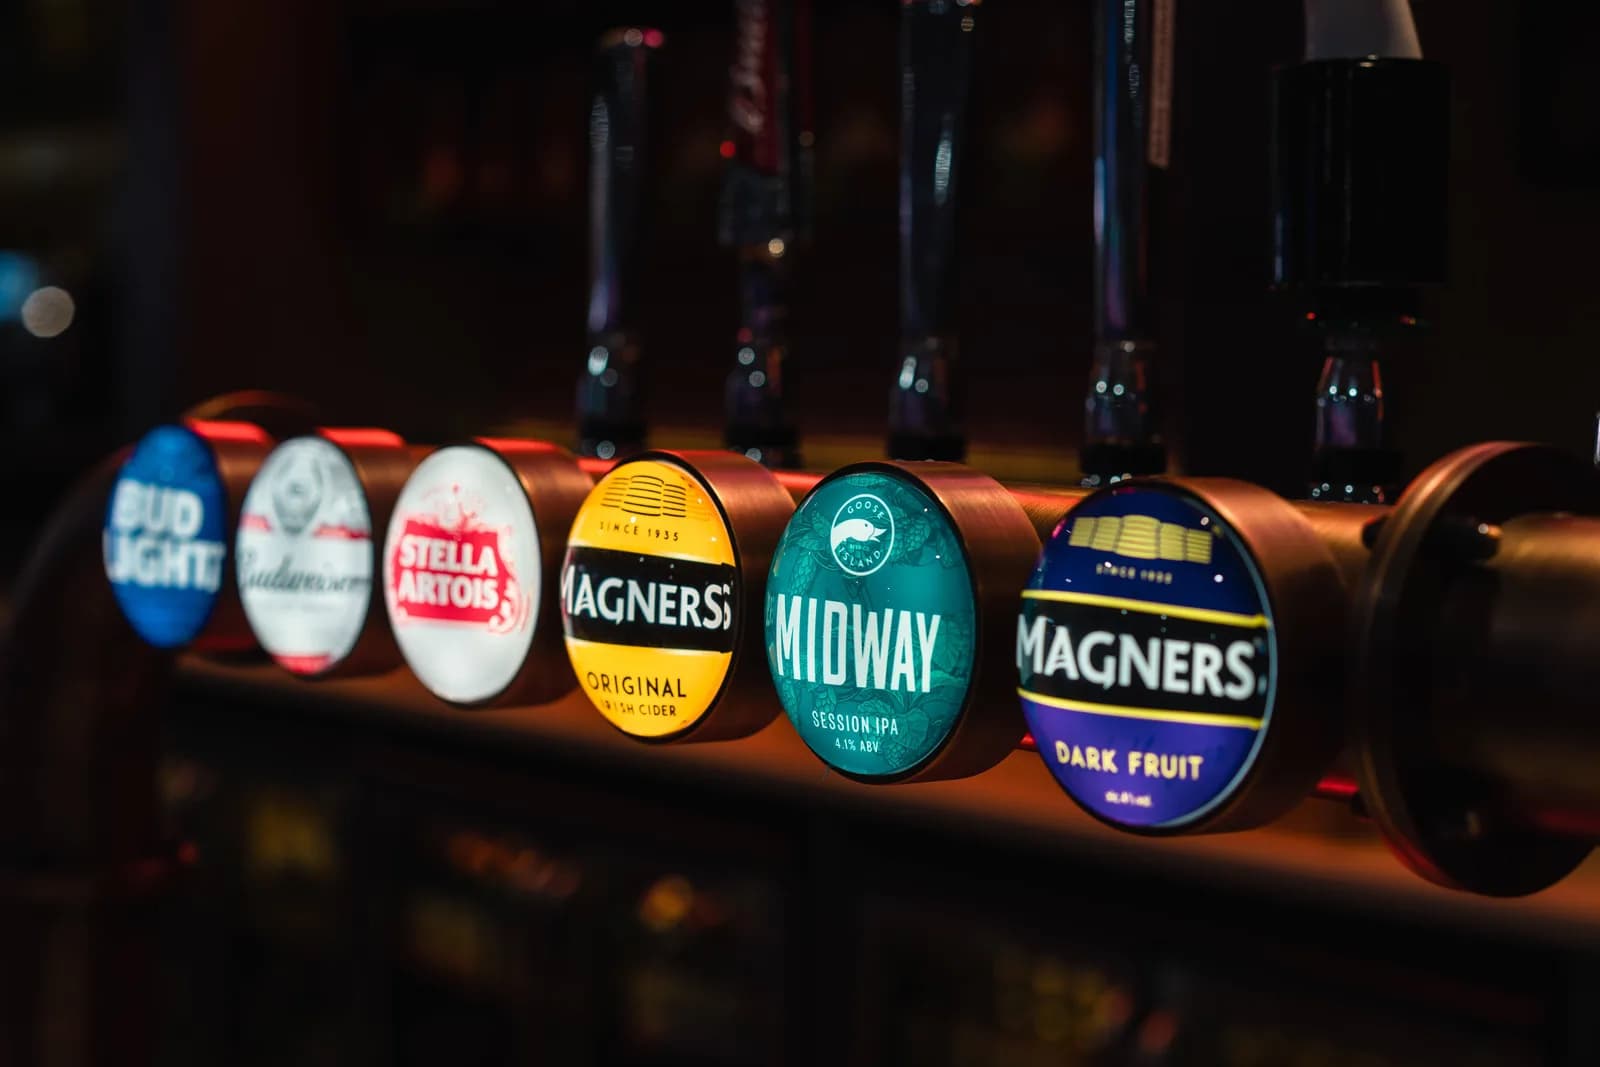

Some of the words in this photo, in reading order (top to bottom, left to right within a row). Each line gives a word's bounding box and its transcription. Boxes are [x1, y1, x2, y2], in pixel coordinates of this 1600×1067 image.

[112, 478, 202, 538] BUD
[847, 501, 885, 519] GOOSE
[600, 521, 638, 536] SINCE
[648, 527, 679, 542] 1935
[401, 535, 498, 577] STELLA
[839, 546, 881, 568] ISLAND
[399, 569, 499, 610] ARTOIS
[775, 593, 941, 693] MIDWAY
[1016, 613, 1256, 701] MAGNERS
[587, 672, 687, 698] ORIGINAL
[639, 704, 676, 717] CIDER
[812, 710, 870, 733] SESSION
[875, 717, 899, 736] IPA
[835, 737, 857, 751] 4.1%
[860, 740, 879, 753] ABV
[1055, 741, 1118, 774] DARK
[1128, 752, 1204, 781] FRUIT
